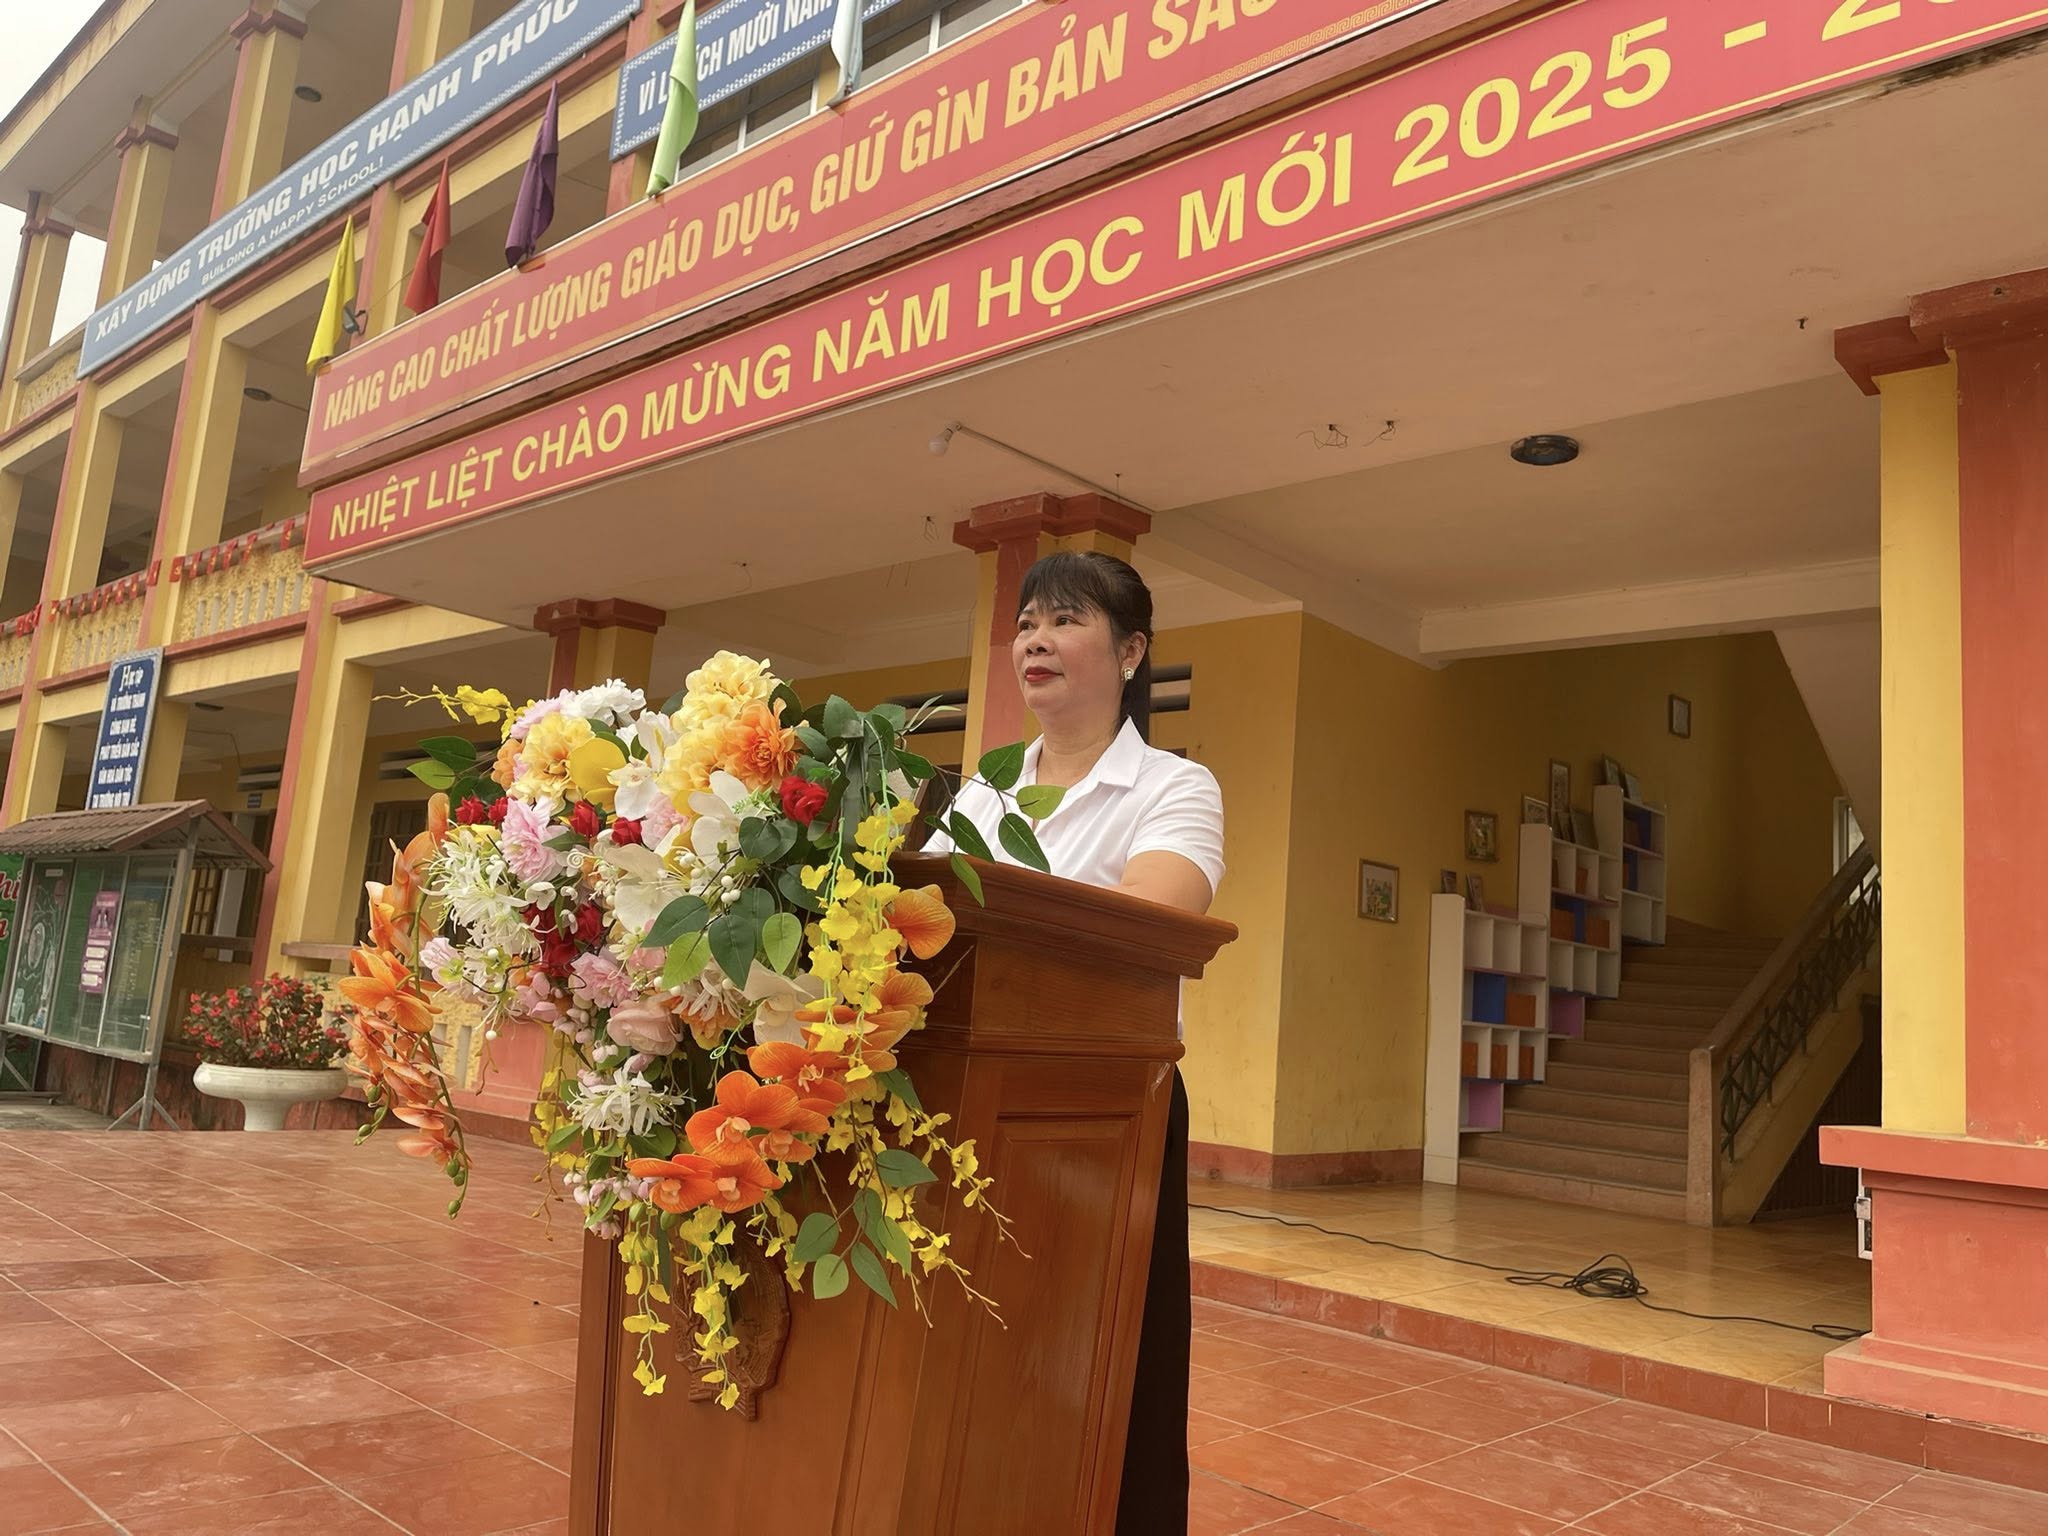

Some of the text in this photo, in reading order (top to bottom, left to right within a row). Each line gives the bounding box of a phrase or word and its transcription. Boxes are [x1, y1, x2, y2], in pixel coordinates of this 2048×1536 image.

[94, 300, 133, 343] XÂY
[135, 258, 191, 314] DỰNG
[198, 187, 292, 270] TRƯỜNG
[299, 140, 359, 200] HỌC
[366, 68, 461, 154] HẠNH
[201, 155, 384, 285] BUILDING A HAPPY SCHOOL!
[323, 370, 384, 431] NÂNG
[388, 346, 435, 402] CAO
[440, 299, 509, 379] CHẤT
[511, 261, 613, 347] LƯỢNG
[621, 217, 703, 300] GIÁO
[712, 175, 800, 260] DỤC,
[810, 110, 894, 215] GIỮ
[900, 79, 990, 173] GÌN
[1004, 11, 1128, 128] BẢN
[329, 475, 420, 541] NHIỆT
[426, 446, 503, 510] LIỆT
[511, 403, 629, 482] CHÀO
[641, 343, 792, 440] MỪNG
[812, 282, 950, 383] NĂM
[976, 215, 1144, 328] HỌC
[1178, 131, 1352, 260] MỚI
[1391, 16, 1672, 187] 2025
